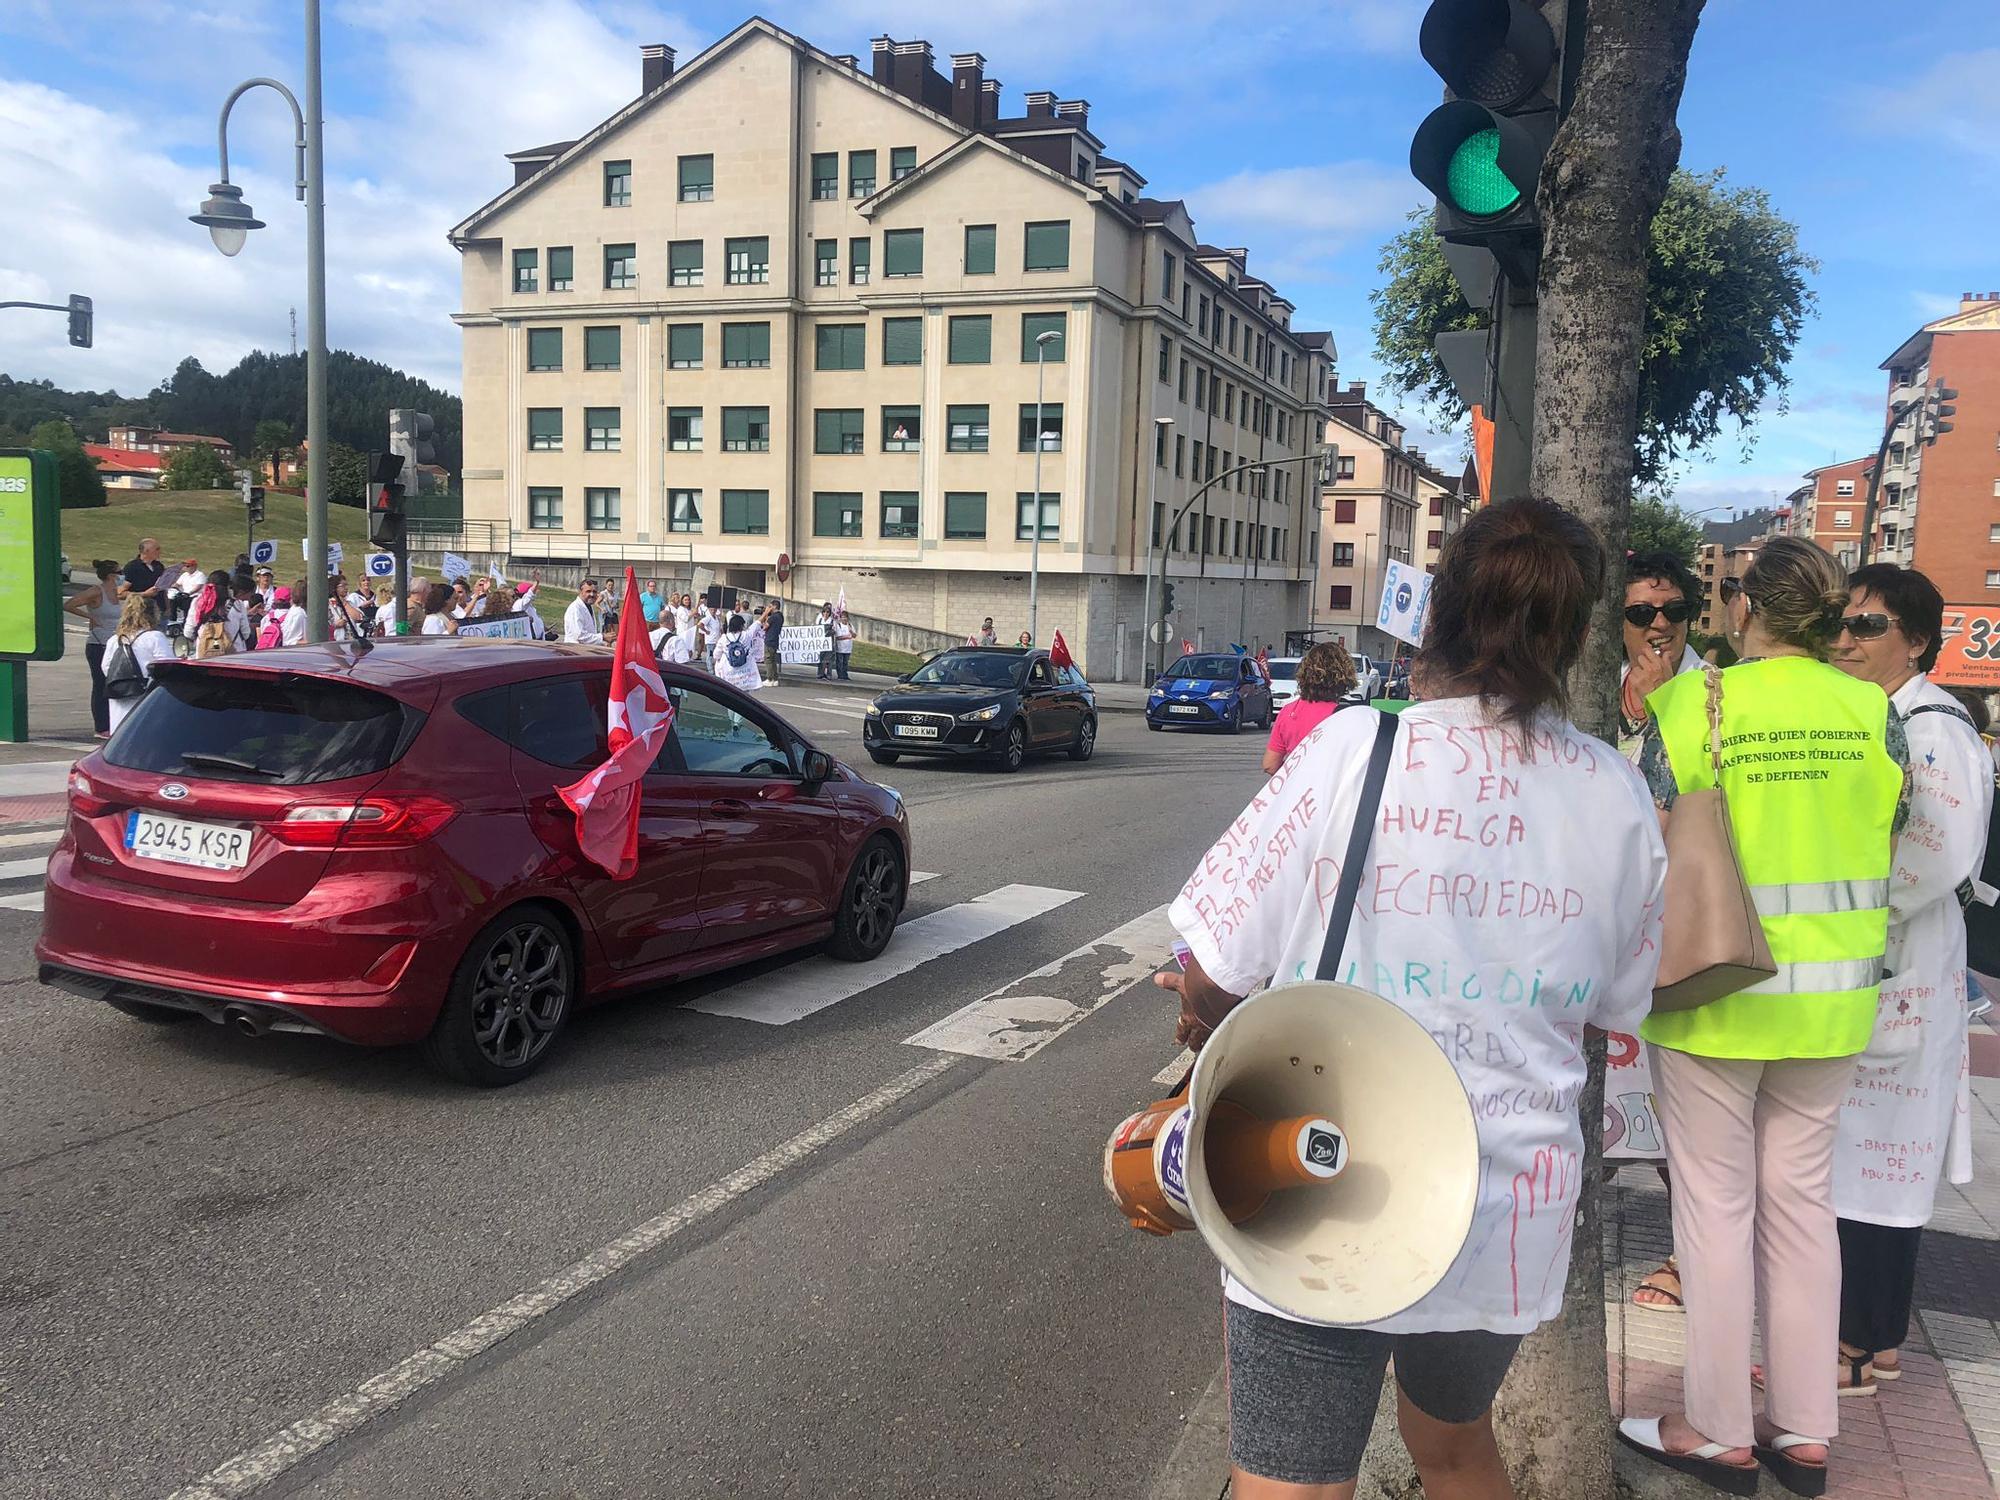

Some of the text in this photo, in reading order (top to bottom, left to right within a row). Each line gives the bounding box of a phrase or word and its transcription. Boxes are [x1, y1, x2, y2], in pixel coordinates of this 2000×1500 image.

[779, 627, 823, 639] ONVENIO
[779, 639, 830, 651] GNO PARA
[800, 652, 820, 663] SAD
[901, 726, 919, 735] 1095
[1405, 718, 1597, 774] ESTAMOS
[1703, 729, 1871, 753] GBIERNE QUIEN GOBIERNE
[1721, 756, 1737, 769] AS
[1737, 751, 1806, 766] PENSIONES
[1746, 773, 1763, 784] SE
[1905, 762, 1950, 781] OMOS
[1476, 775, 1521, 802] EN
[1181, 728, 1324, 901] DE ESTE A OESTE
[1382, 804, 1526, 847] HUELGA
[138, 820, 192, 851] 2945
[199, 830, 242, 861] KSR
[1212, 787, 1318, 953] ESTA PRESENTE
[1896, 866, 1919, 885] POR
[1194, 894, 1226, 930] EL
[1887, 1158, 1906, 1169] DE
